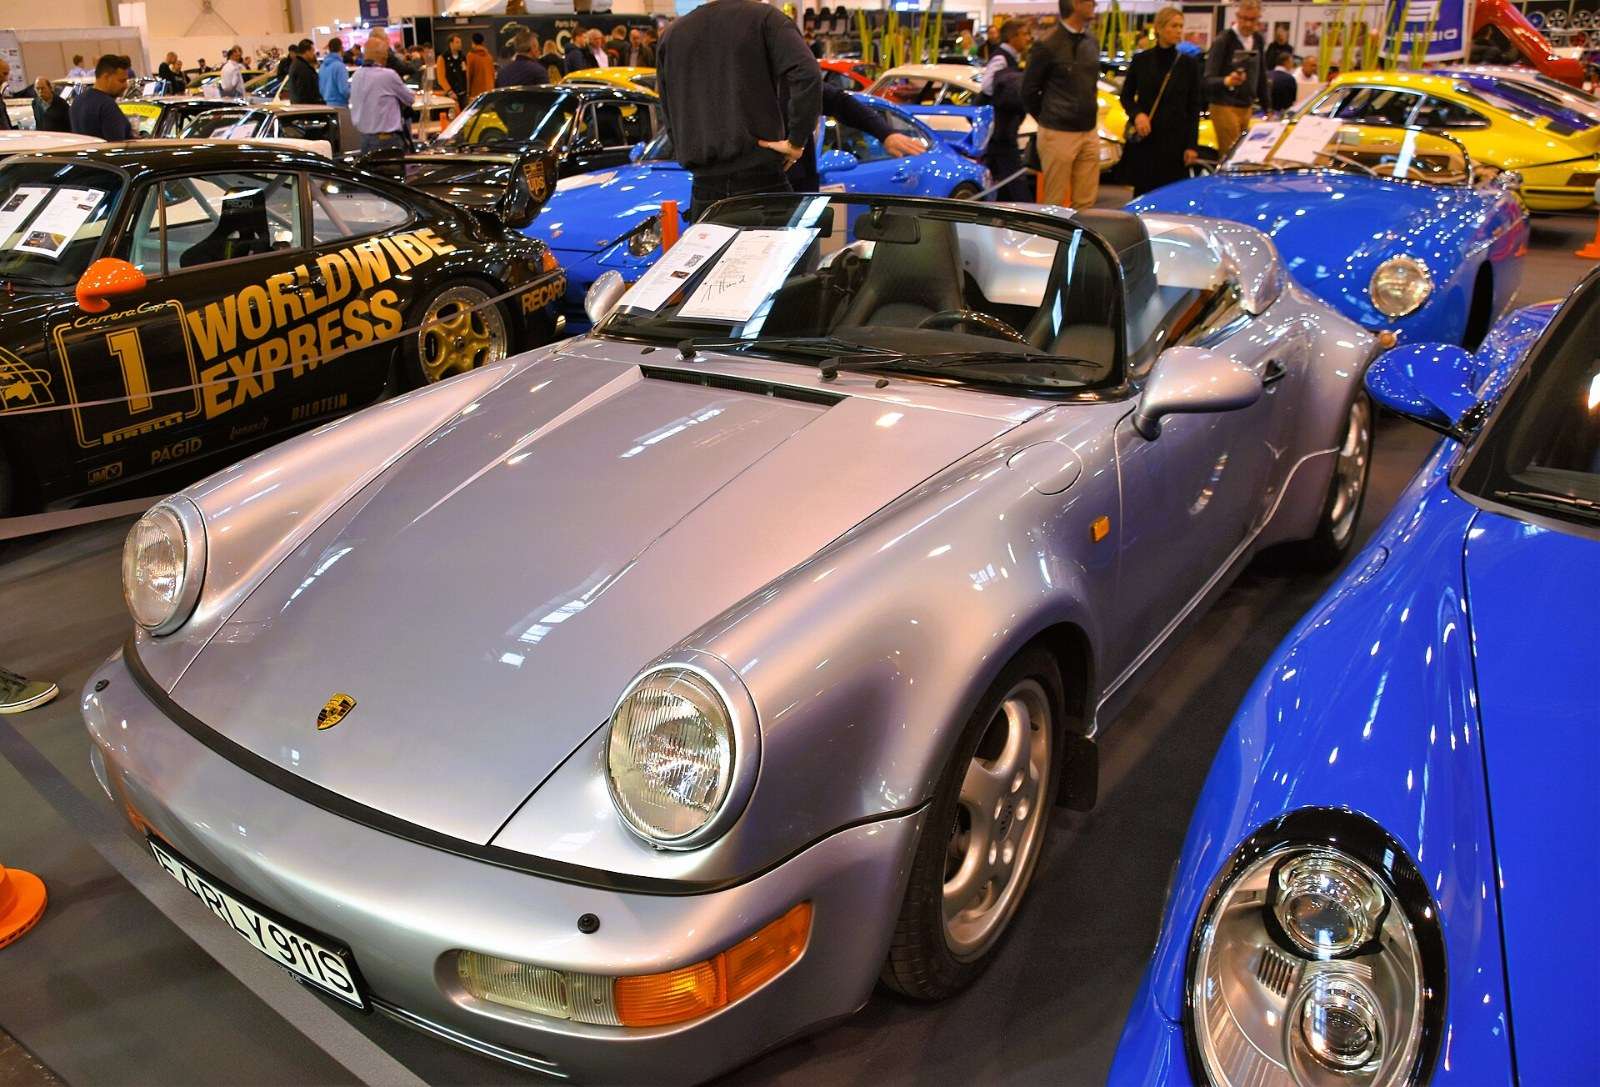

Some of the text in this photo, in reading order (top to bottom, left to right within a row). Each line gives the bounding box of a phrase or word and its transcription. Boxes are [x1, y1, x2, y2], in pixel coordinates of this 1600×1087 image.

[74, 308, 137, 328] Carrera
[187, 228, 457, 363] WORLDWIDE
[522, 276, 567, 315] RECARO
[106, 327, 153, 415] 1
[201, 289, 403, 420] EXPRESS
[103, 411, 183, 445] PIRELLI
[152, 437, 203, 464] PAGID
[267, 923, 354, 995] 911S
